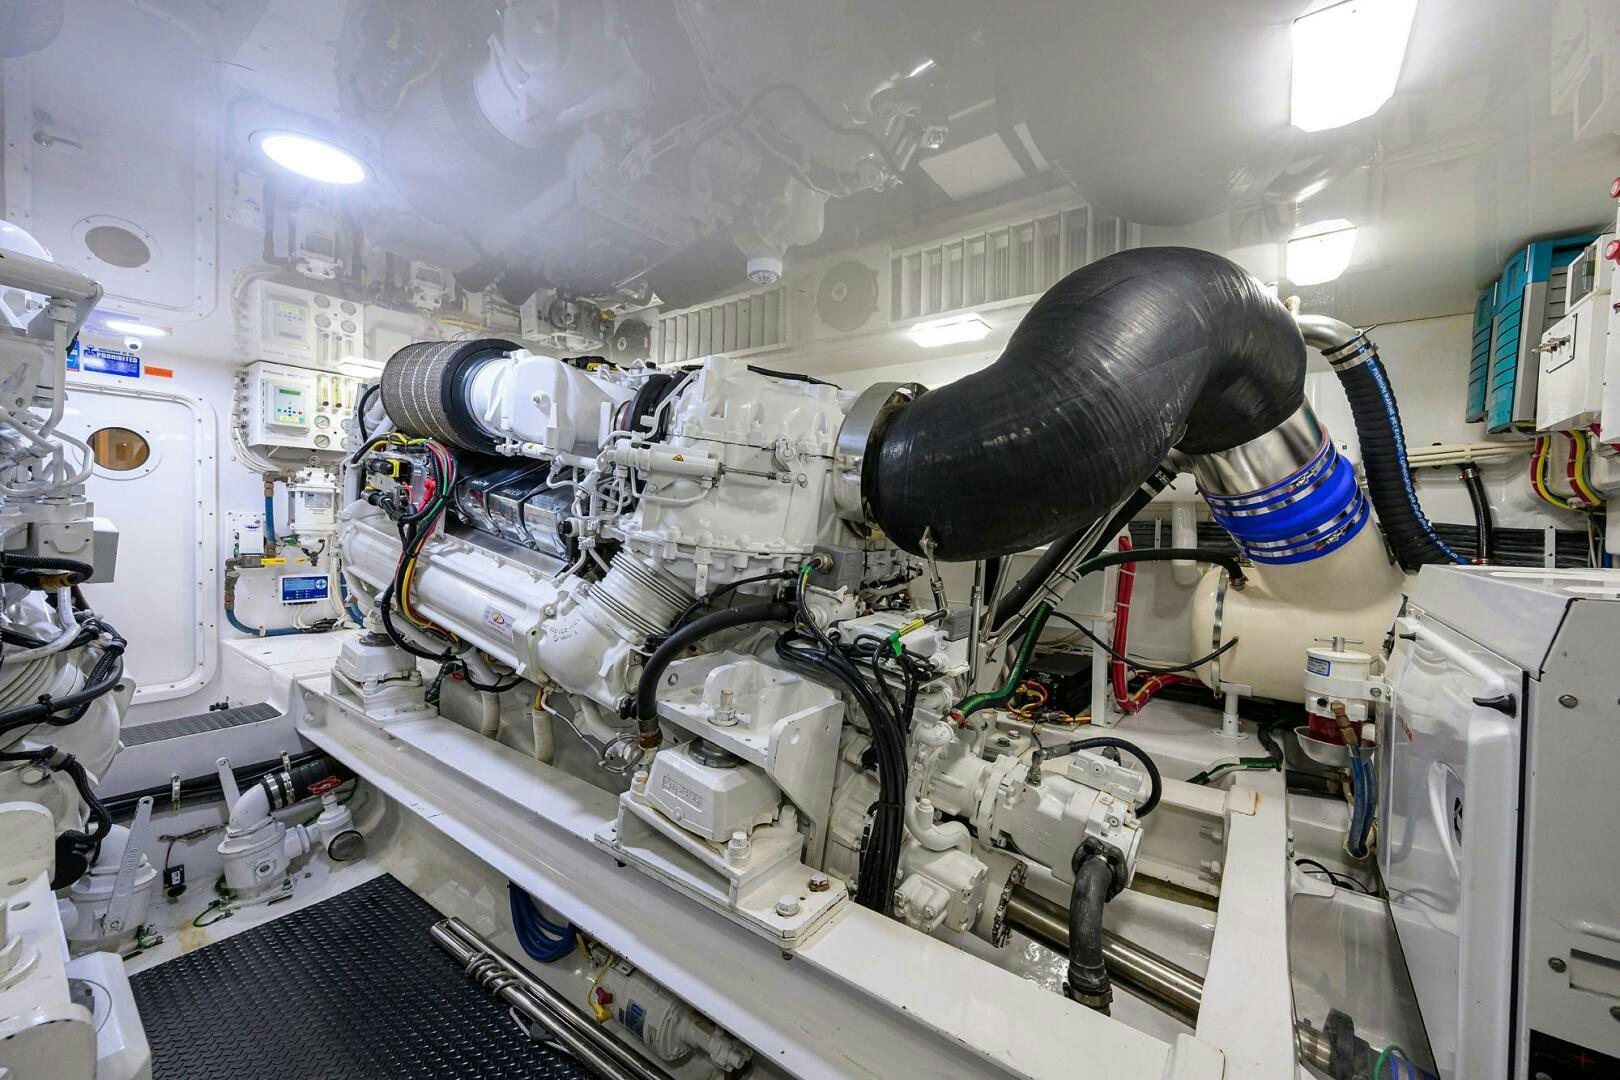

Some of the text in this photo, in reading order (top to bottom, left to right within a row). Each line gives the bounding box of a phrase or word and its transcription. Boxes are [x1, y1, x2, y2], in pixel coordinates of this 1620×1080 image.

[96, 351, 138, 363] PROHIBITED
[1372, 366, 1388, 393] PREMIUM
[1383, 392, 1395, 415] MARINE
